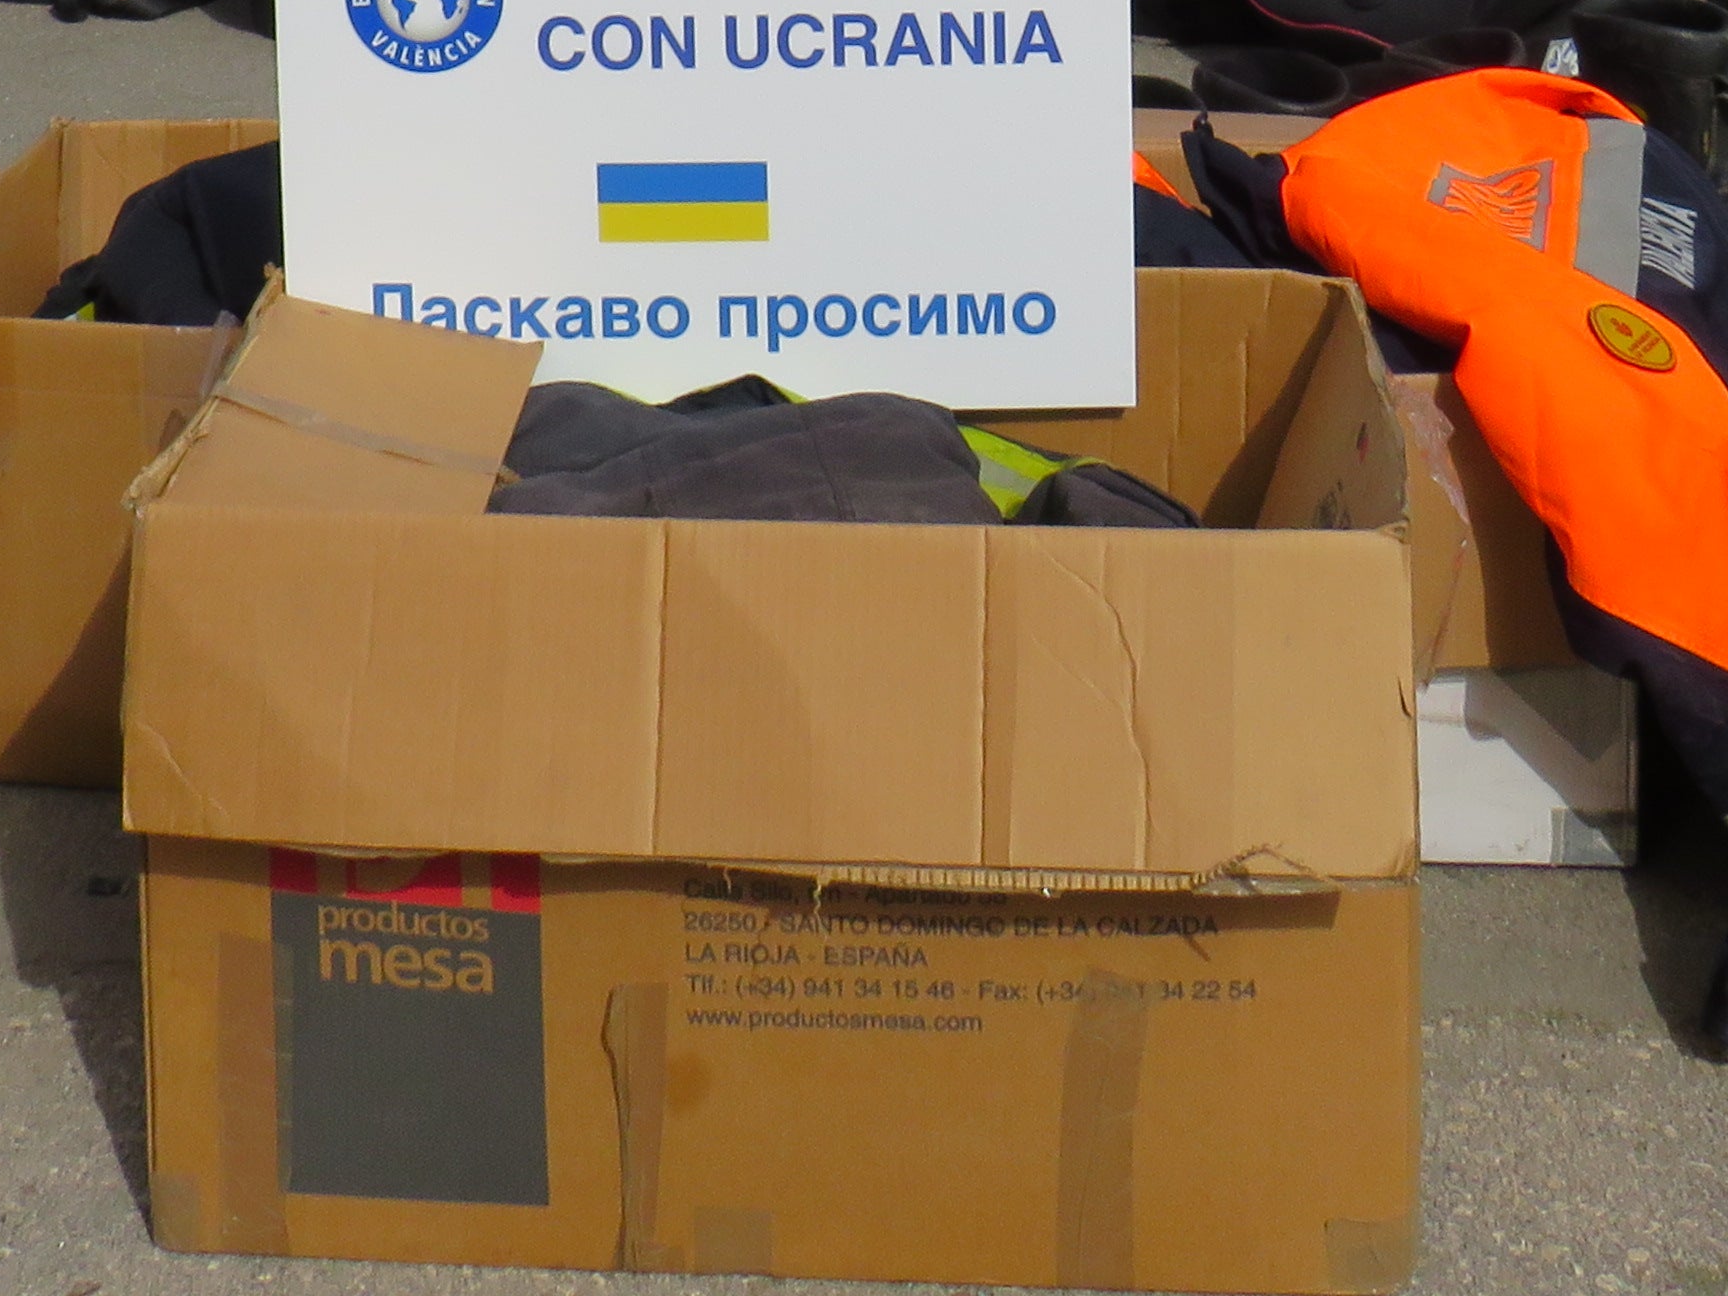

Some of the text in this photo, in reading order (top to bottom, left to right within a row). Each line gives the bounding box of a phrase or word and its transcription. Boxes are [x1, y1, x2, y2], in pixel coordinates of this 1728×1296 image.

[371, 30, 482, 67] VALÈNCIA
[537, 10, 1064, 72] CON UCRANIA
[718, 291, 1057, 352] просимо
[318, 899, 489, 944] productos
[683, 911, 1220, 938] 26250 SANTO DOMINGO DE LA CALZADA
[319, 937, 495, 996] mesa
[684, 941, 929, 968] LA RIOJA ESPAÑA
[803, 976, 845, 999] 941
[853, 977, 882, 999] 34
[892, 978, 919, 1000] 15
[926, 979, 955, 1001] 46
[978, 980, 1029, 1002] Fax:
[1191, 980, 1222, 1001] 22
[1228, 979, 1258, 1001] 54
[685, 1008, 983, 1033] www.productosmesa.com
